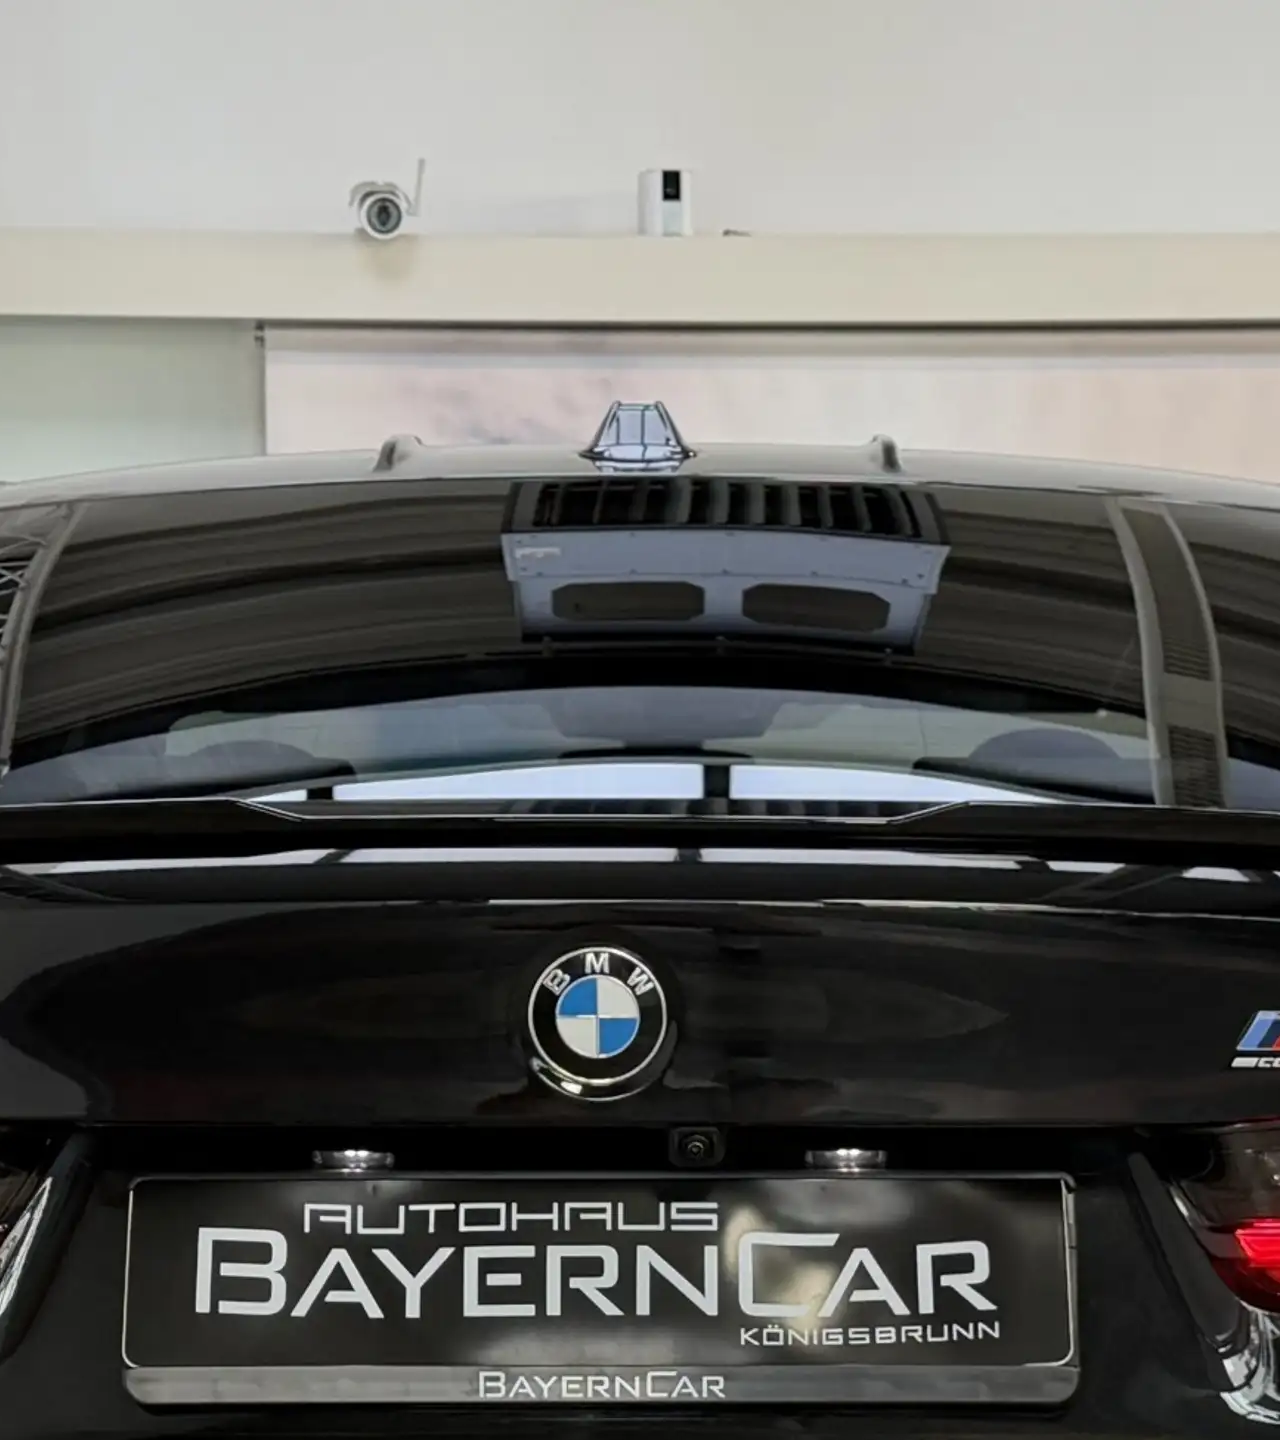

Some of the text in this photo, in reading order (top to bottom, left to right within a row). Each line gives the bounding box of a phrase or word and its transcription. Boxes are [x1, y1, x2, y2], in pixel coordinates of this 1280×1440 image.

[543, 952, 655, 996] BMW
[303, 1202, 719, 1235] AUTOHAUS
[740, 1321, 1000, 1346] KÖNIGSBRUNN
